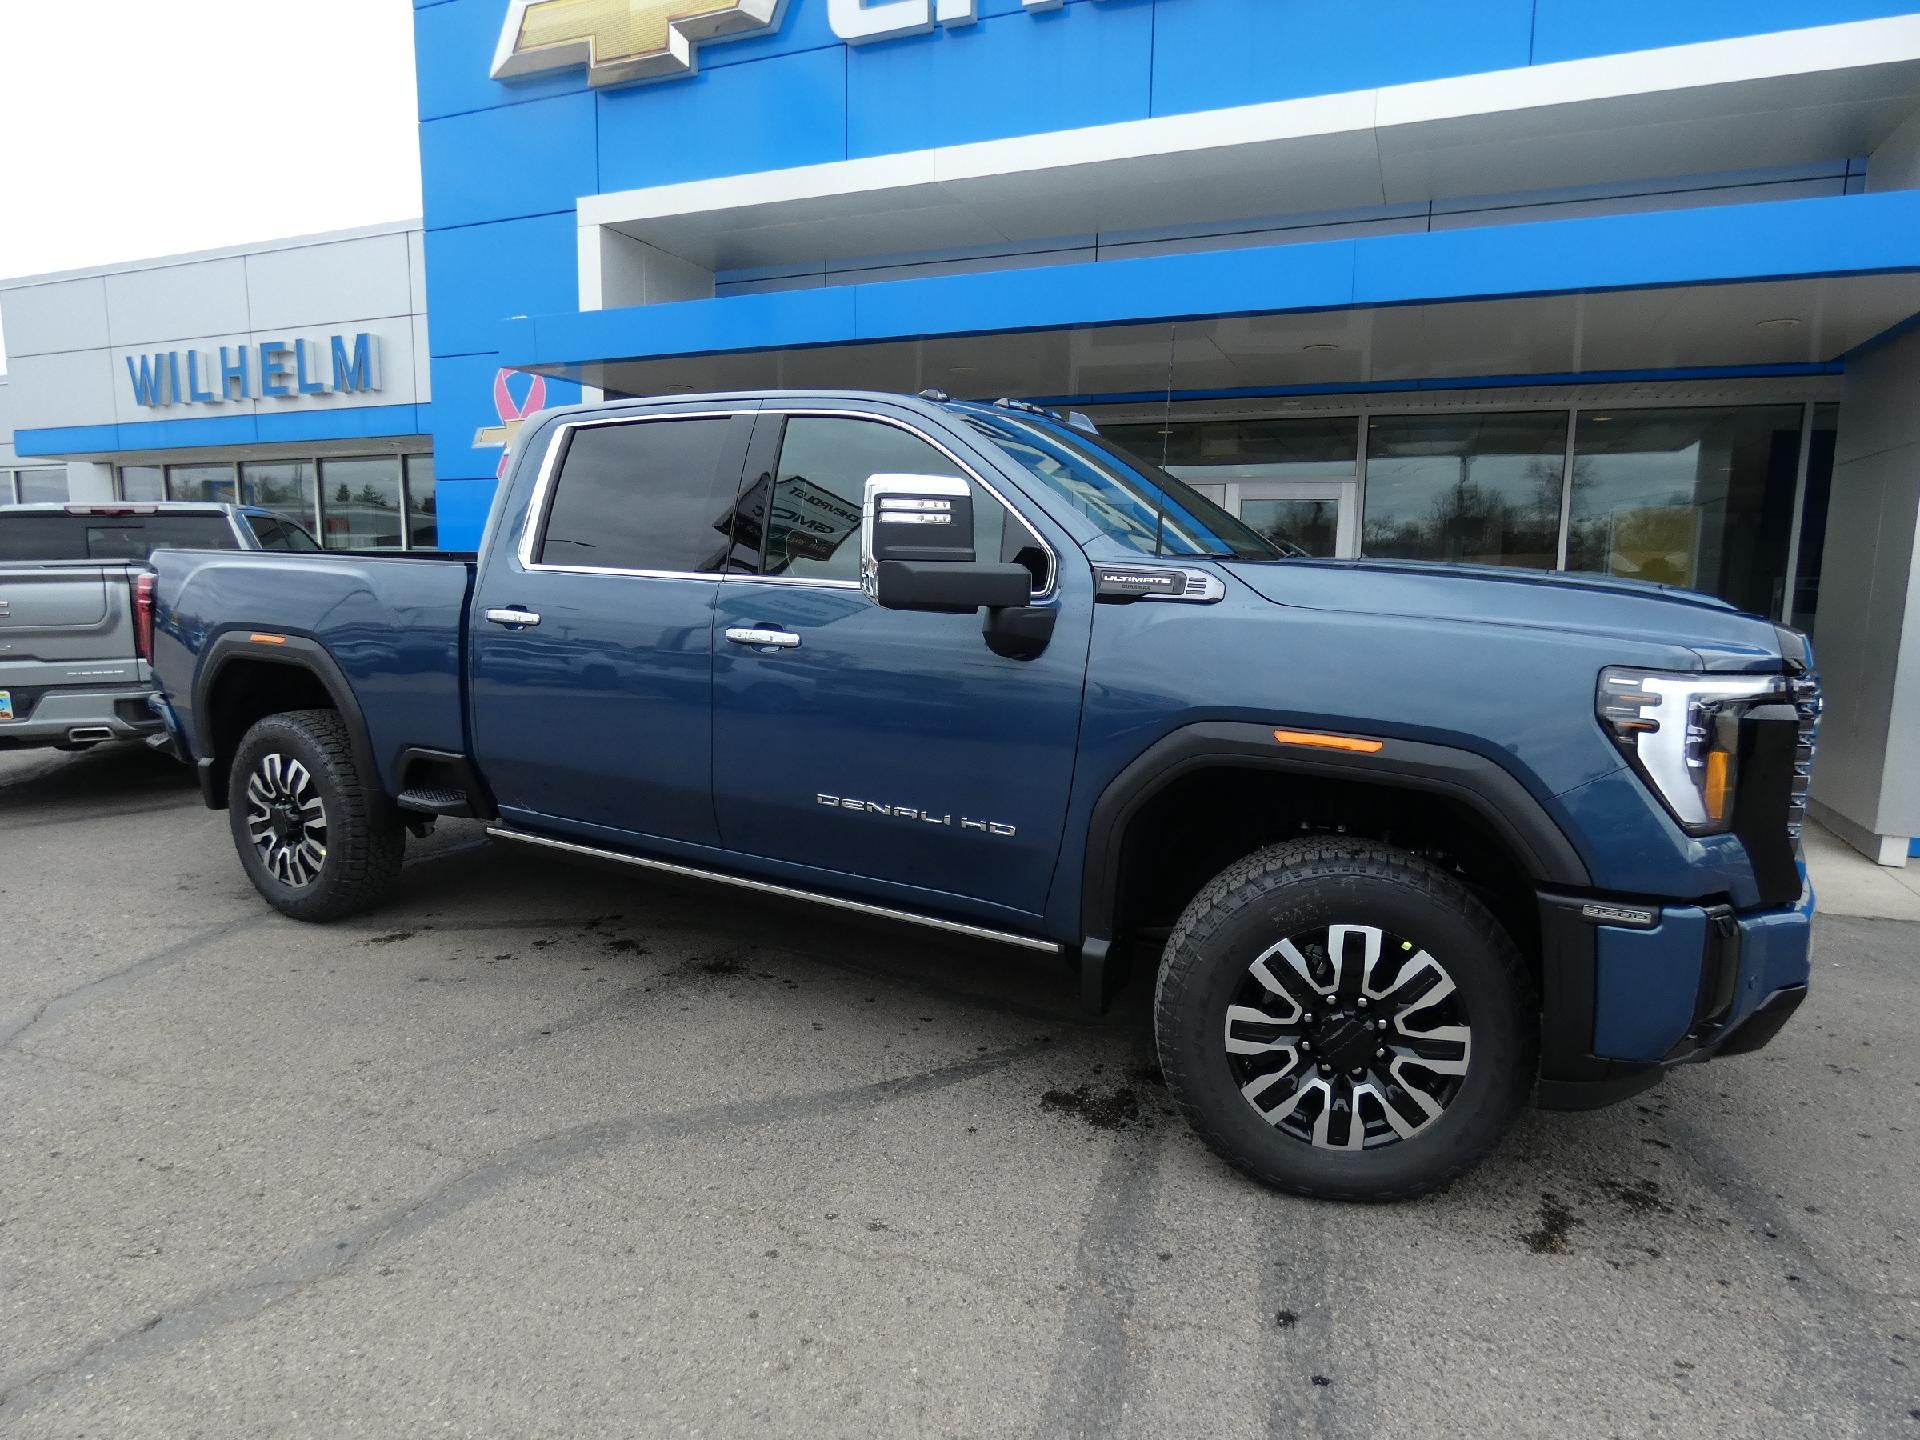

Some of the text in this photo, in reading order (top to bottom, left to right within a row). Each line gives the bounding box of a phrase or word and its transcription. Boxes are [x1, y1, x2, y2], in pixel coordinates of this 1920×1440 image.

[126, 332, 375, 407] WILHELM
[1103, 574, 1172, 585] ULTIMATE
[816, 793, 1016, 837] DENALI HD
